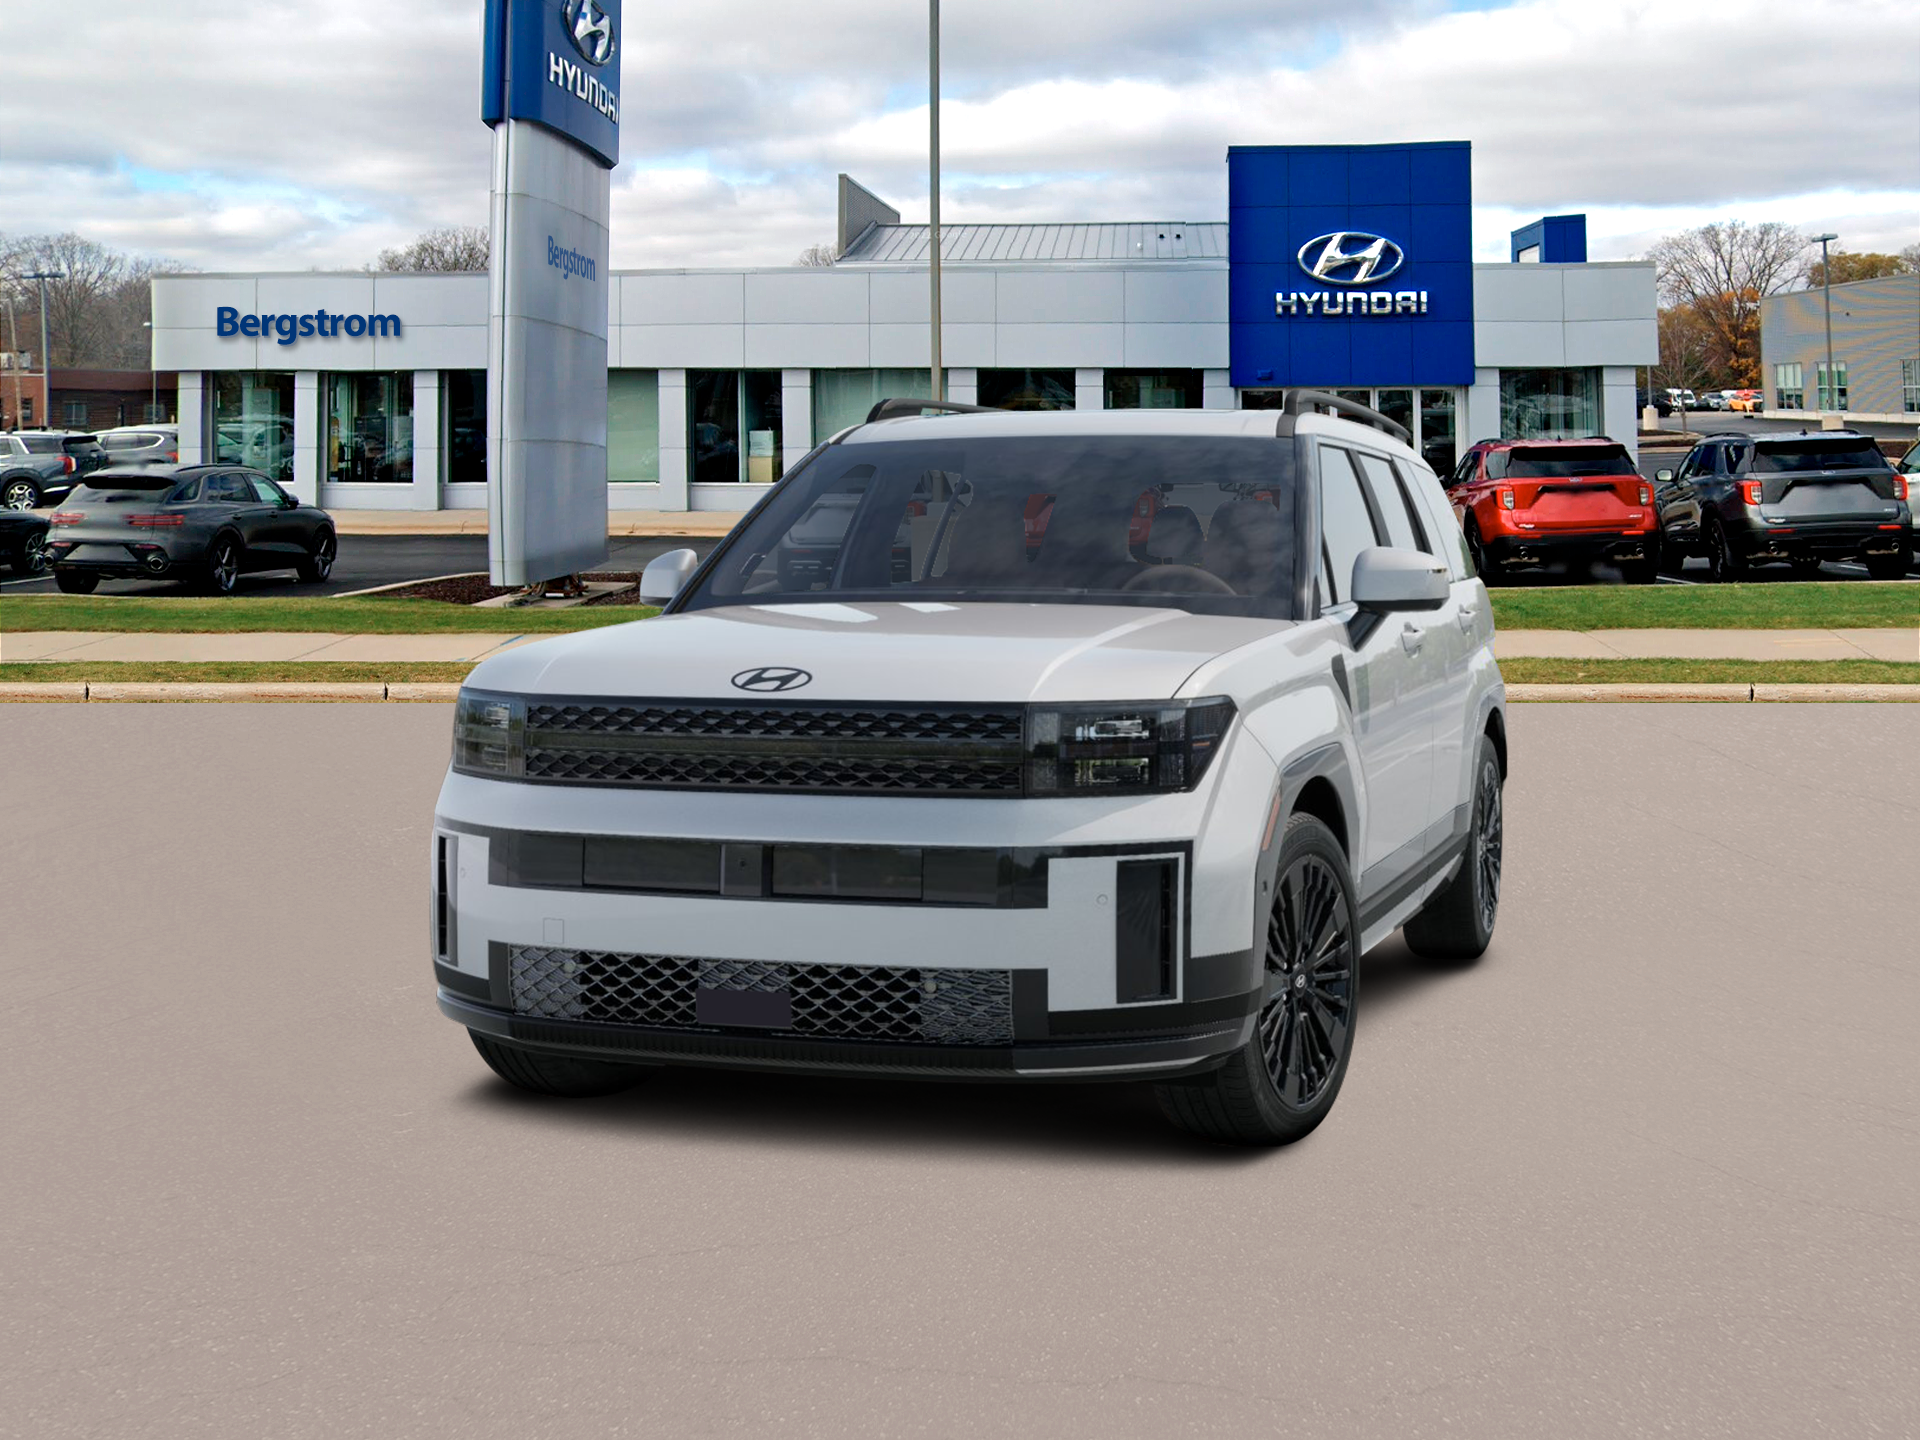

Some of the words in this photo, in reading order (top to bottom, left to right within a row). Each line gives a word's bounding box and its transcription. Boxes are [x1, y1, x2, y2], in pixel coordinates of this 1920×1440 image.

[549, 51, 619, 124] HYUNDAI
[547, 235, 596, 282] Bergstrom
[1275, 291, 1428, 315] HYUNDAI
[216, 306, 401, 346] Bergstrom
